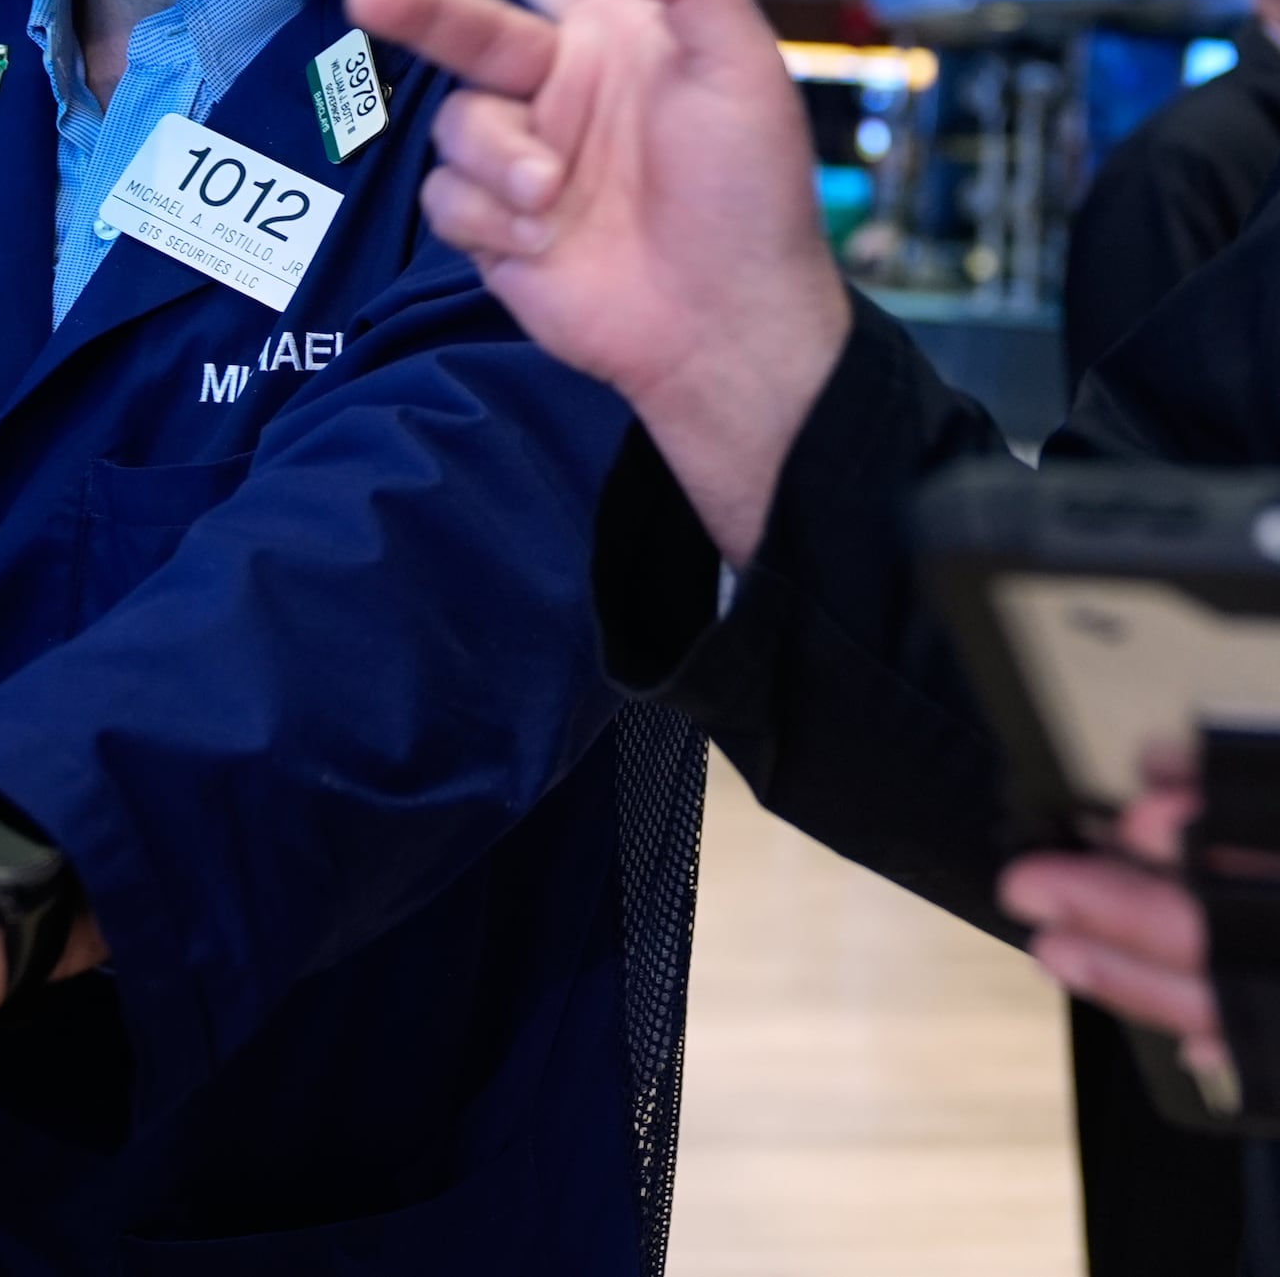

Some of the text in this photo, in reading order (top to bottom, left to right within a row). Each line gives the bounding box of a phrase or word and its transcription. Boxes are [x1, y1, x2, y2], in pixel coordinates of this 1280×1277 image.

[313, 90, 330, 133] BARCLAYS
[325, 82, 341, 125] GOVERNOR
[330, 58, 346, 96] WILLIAM
[340, 102, 355, 126] BOTT
[345, 52, 377, 116] 3979
[125, 180, 184, 219] MICHAEL
[190, 213, 202, 229] A.
[178, 147, 310, 242] 1012
[138, 221, 259, 289] GTS SECURITIES LLC
